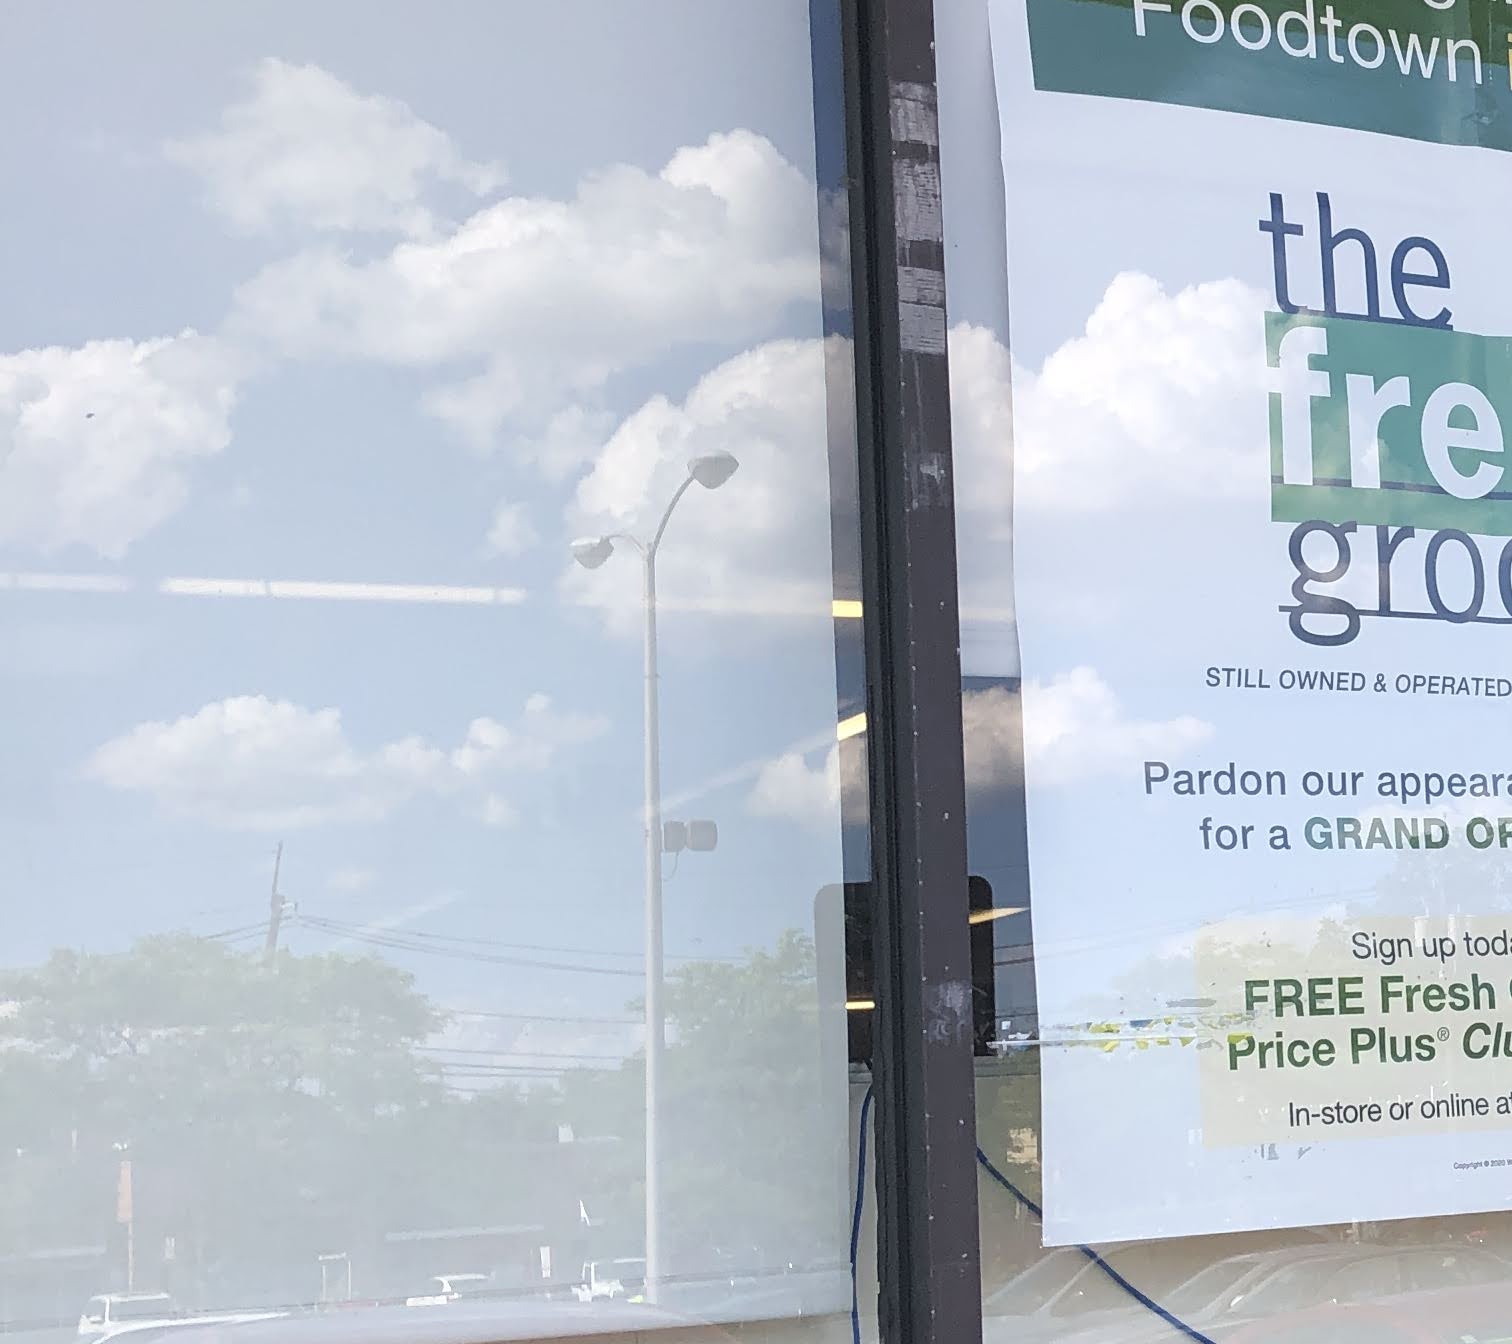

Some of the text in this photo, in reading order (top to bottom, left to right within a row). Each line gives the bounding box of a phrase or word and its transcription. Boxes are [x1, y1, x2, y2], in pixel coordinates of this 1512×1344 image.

[1258, 192, 1453, 330] the
[1205, 667, 1271, 689] STILL
[1279, 669, 1366, 692] OWNED
[1373, 673, 1387, 692] &
[1395, 674, 1512, 697] OPERATED
[1143, 760, 1287, 796] Pardon
[1302, 770, 1364, 797] our
[1199, 817, 1254, 850] for
[1269, 824, 1291, 850] a
[1304, 817, 1450, 850] GRAND
[1352, 932, 1413, 965] Sign
[1423, 935, 1456, 963] up
[1244, 976, 1365, 1017] FREE
[1380, 973, 1497, 1014] Fresh
[1228, 1031, 1336, 1071] Price
[1289, 1099, 1382, 1127] In-store
[1390, 1101, 1414, 1121] or
[1420, 1092, 1489, 1118] online
